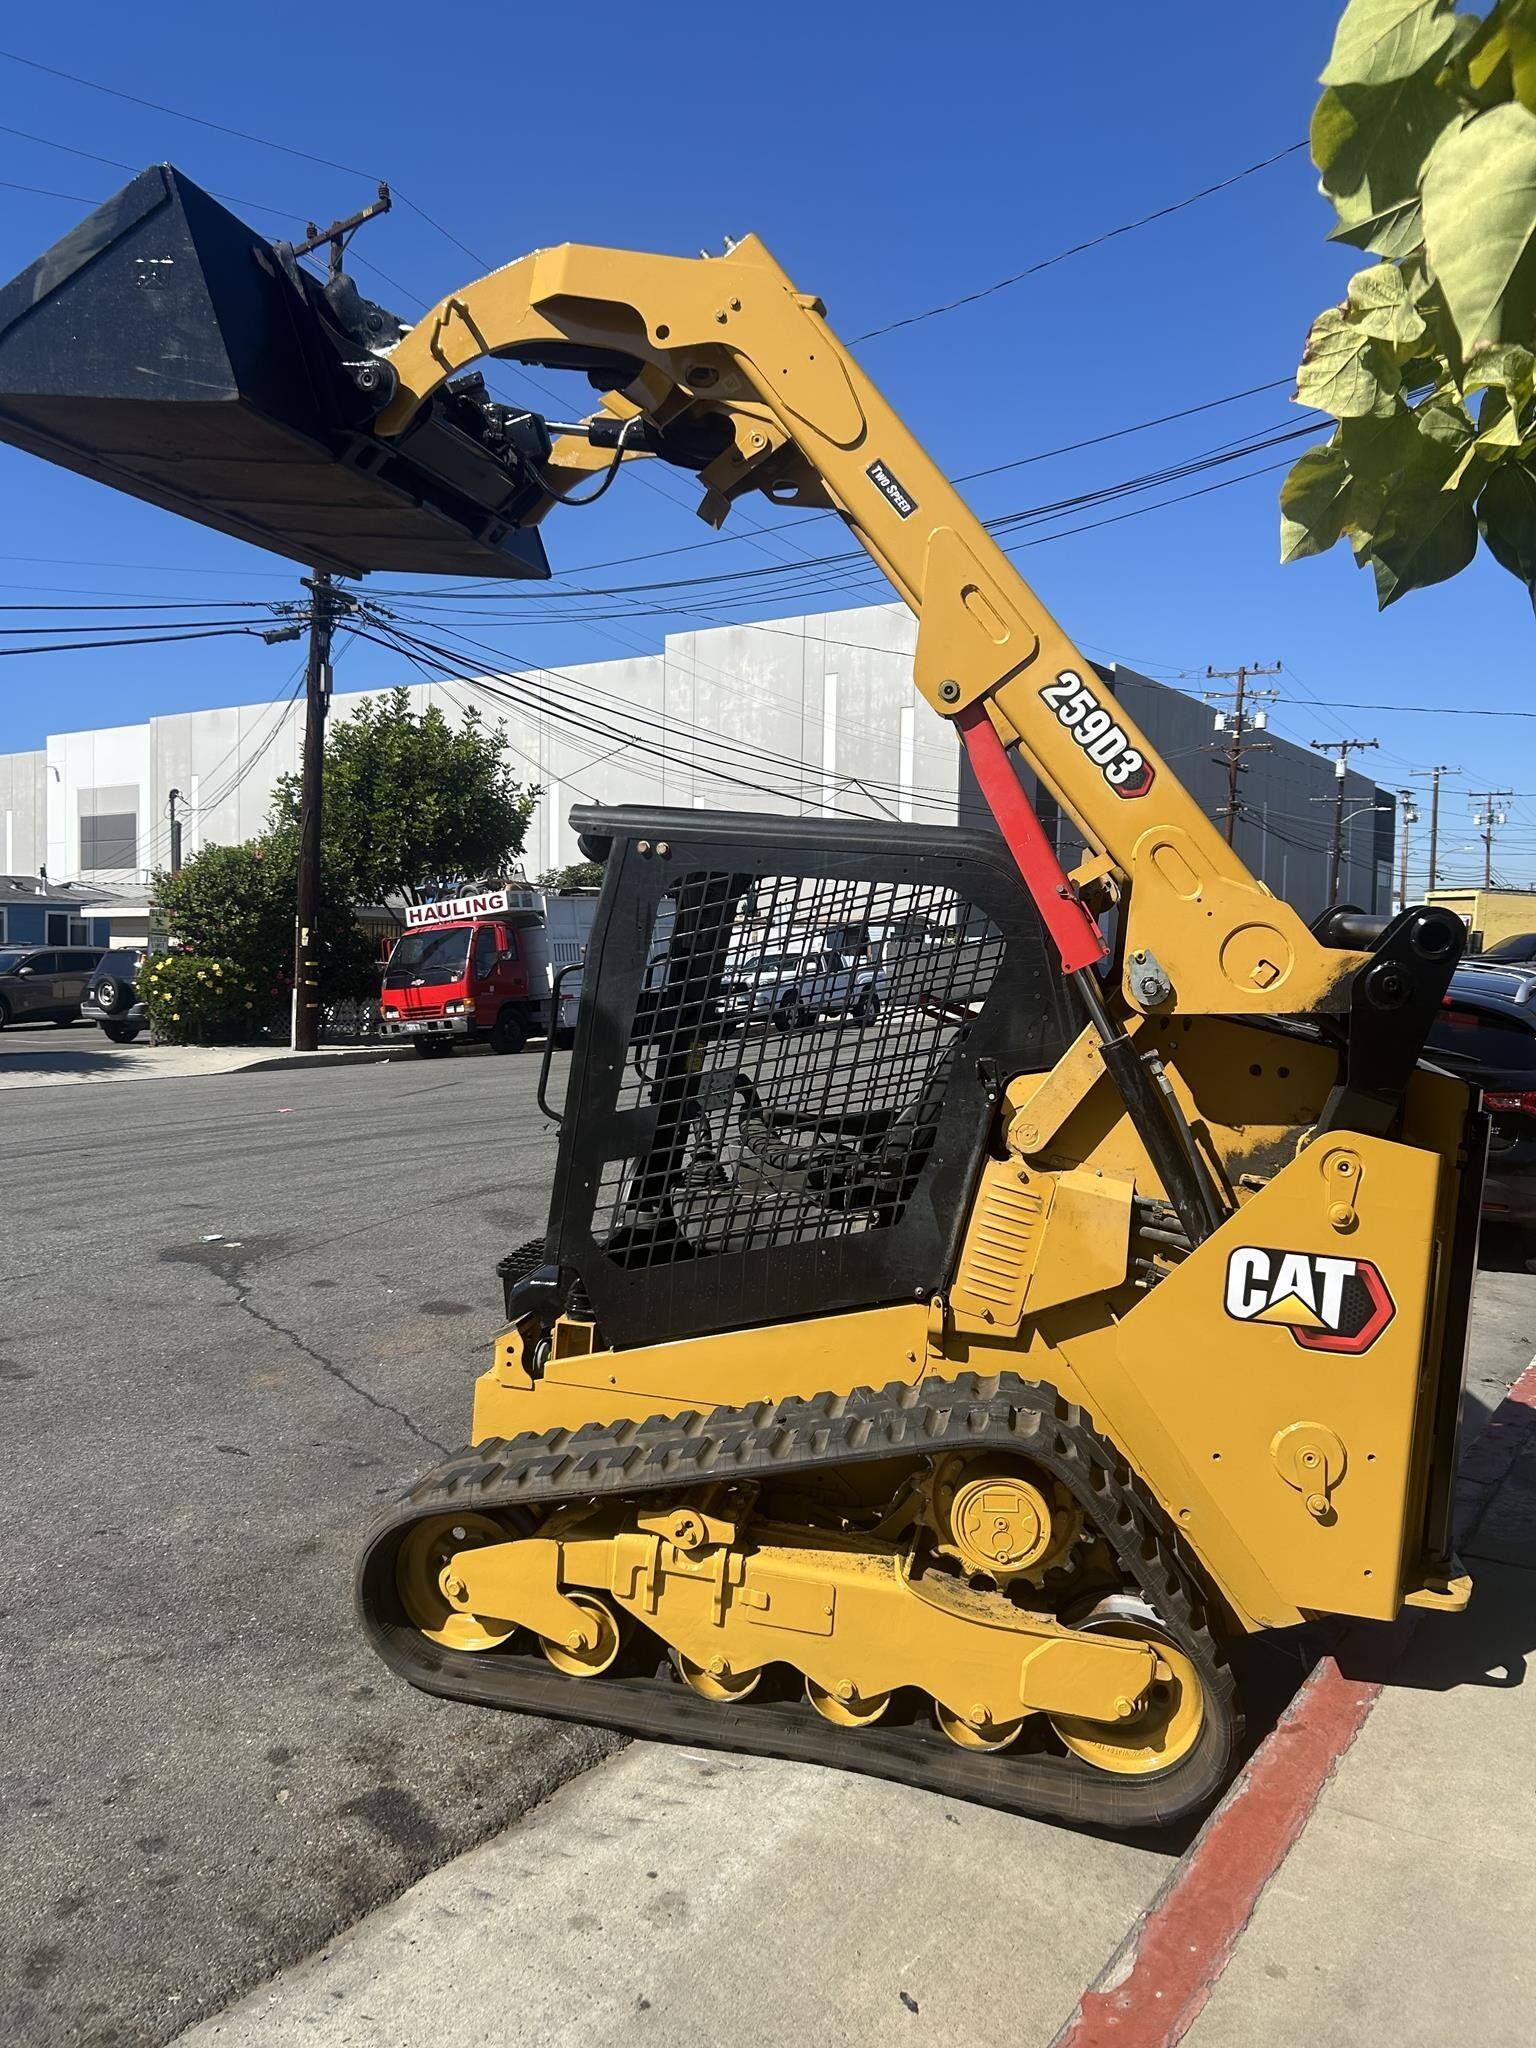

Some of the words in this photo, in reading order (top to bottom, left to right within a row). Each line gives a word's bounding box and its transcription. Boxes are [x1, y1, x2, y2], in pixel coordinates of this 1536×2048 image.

[871, 464, 890, 487] TWO
[886, 484, 911, 512] SPEED
[1040, 671, 1143, 784] 259D3
[409, 895, 503, 923] HAULING
[1226, 1247, 1357, 1330] CAT
